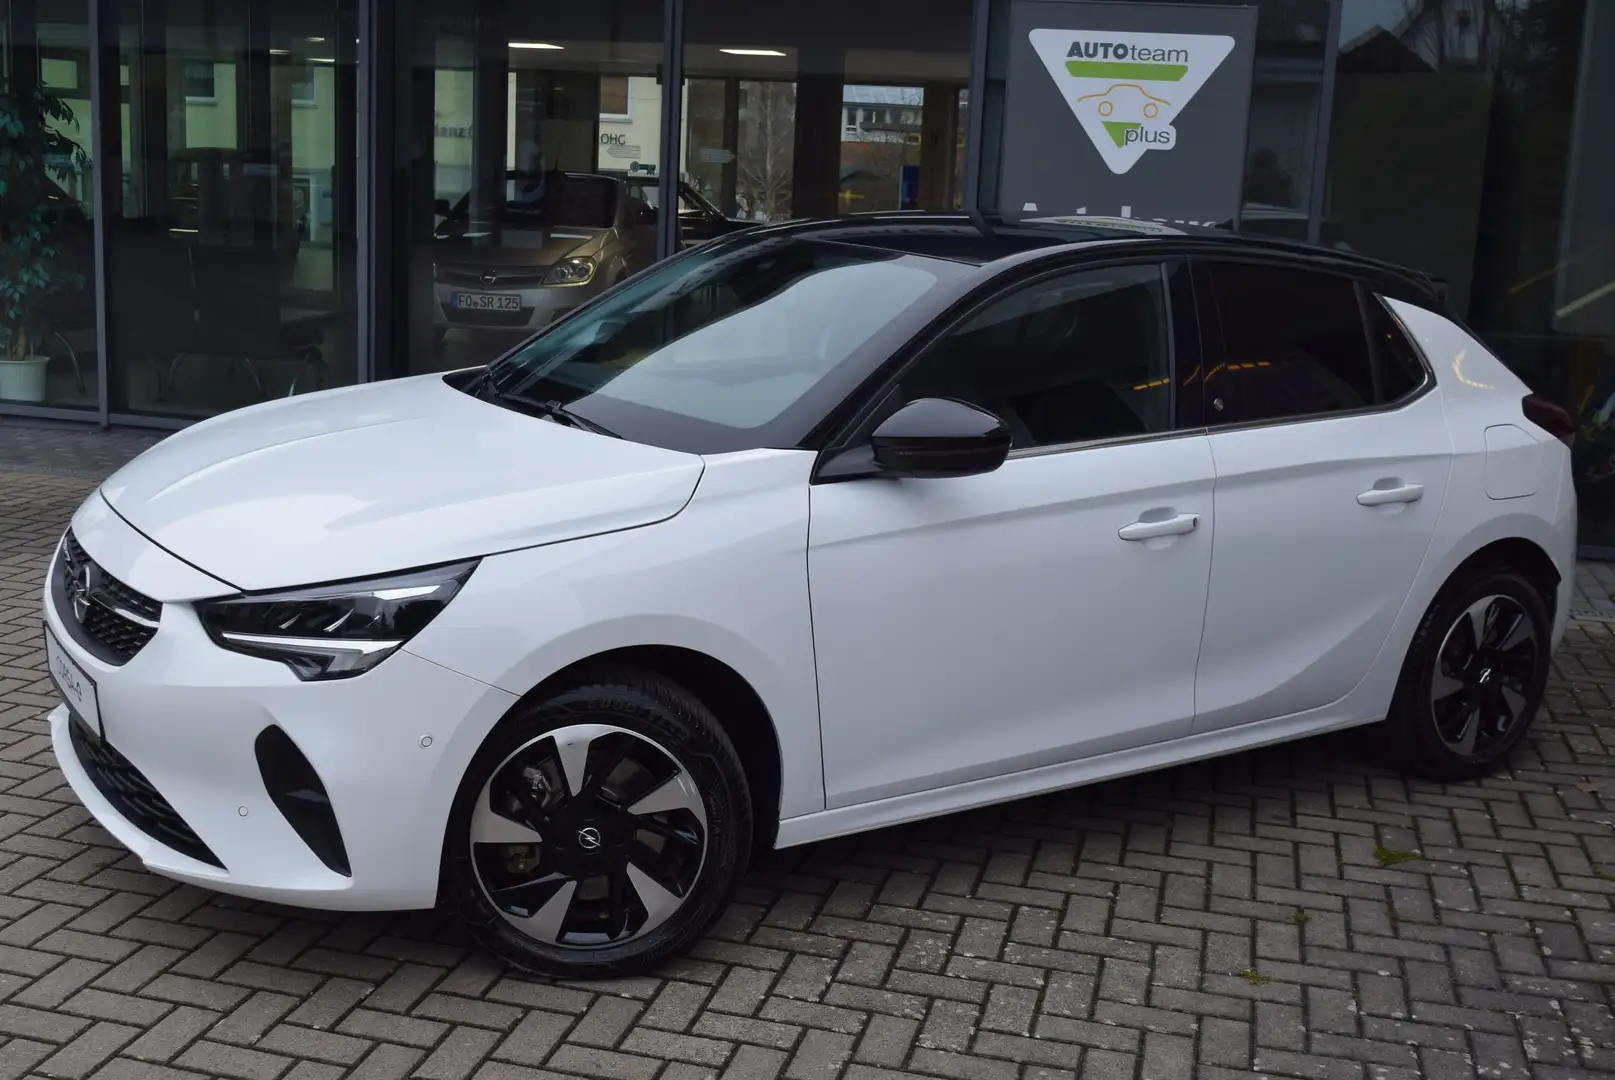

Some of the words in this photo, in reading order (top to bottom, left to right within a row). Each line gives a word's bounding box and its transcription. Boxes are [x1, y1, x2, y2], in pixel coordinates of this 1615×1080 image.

[1066, 41, 1189, 63] AUTOteam
[600, 133, 626, 145] OHG
[1124, 126, 1170, 146] plus
[496, 297, 519, 310] 125
